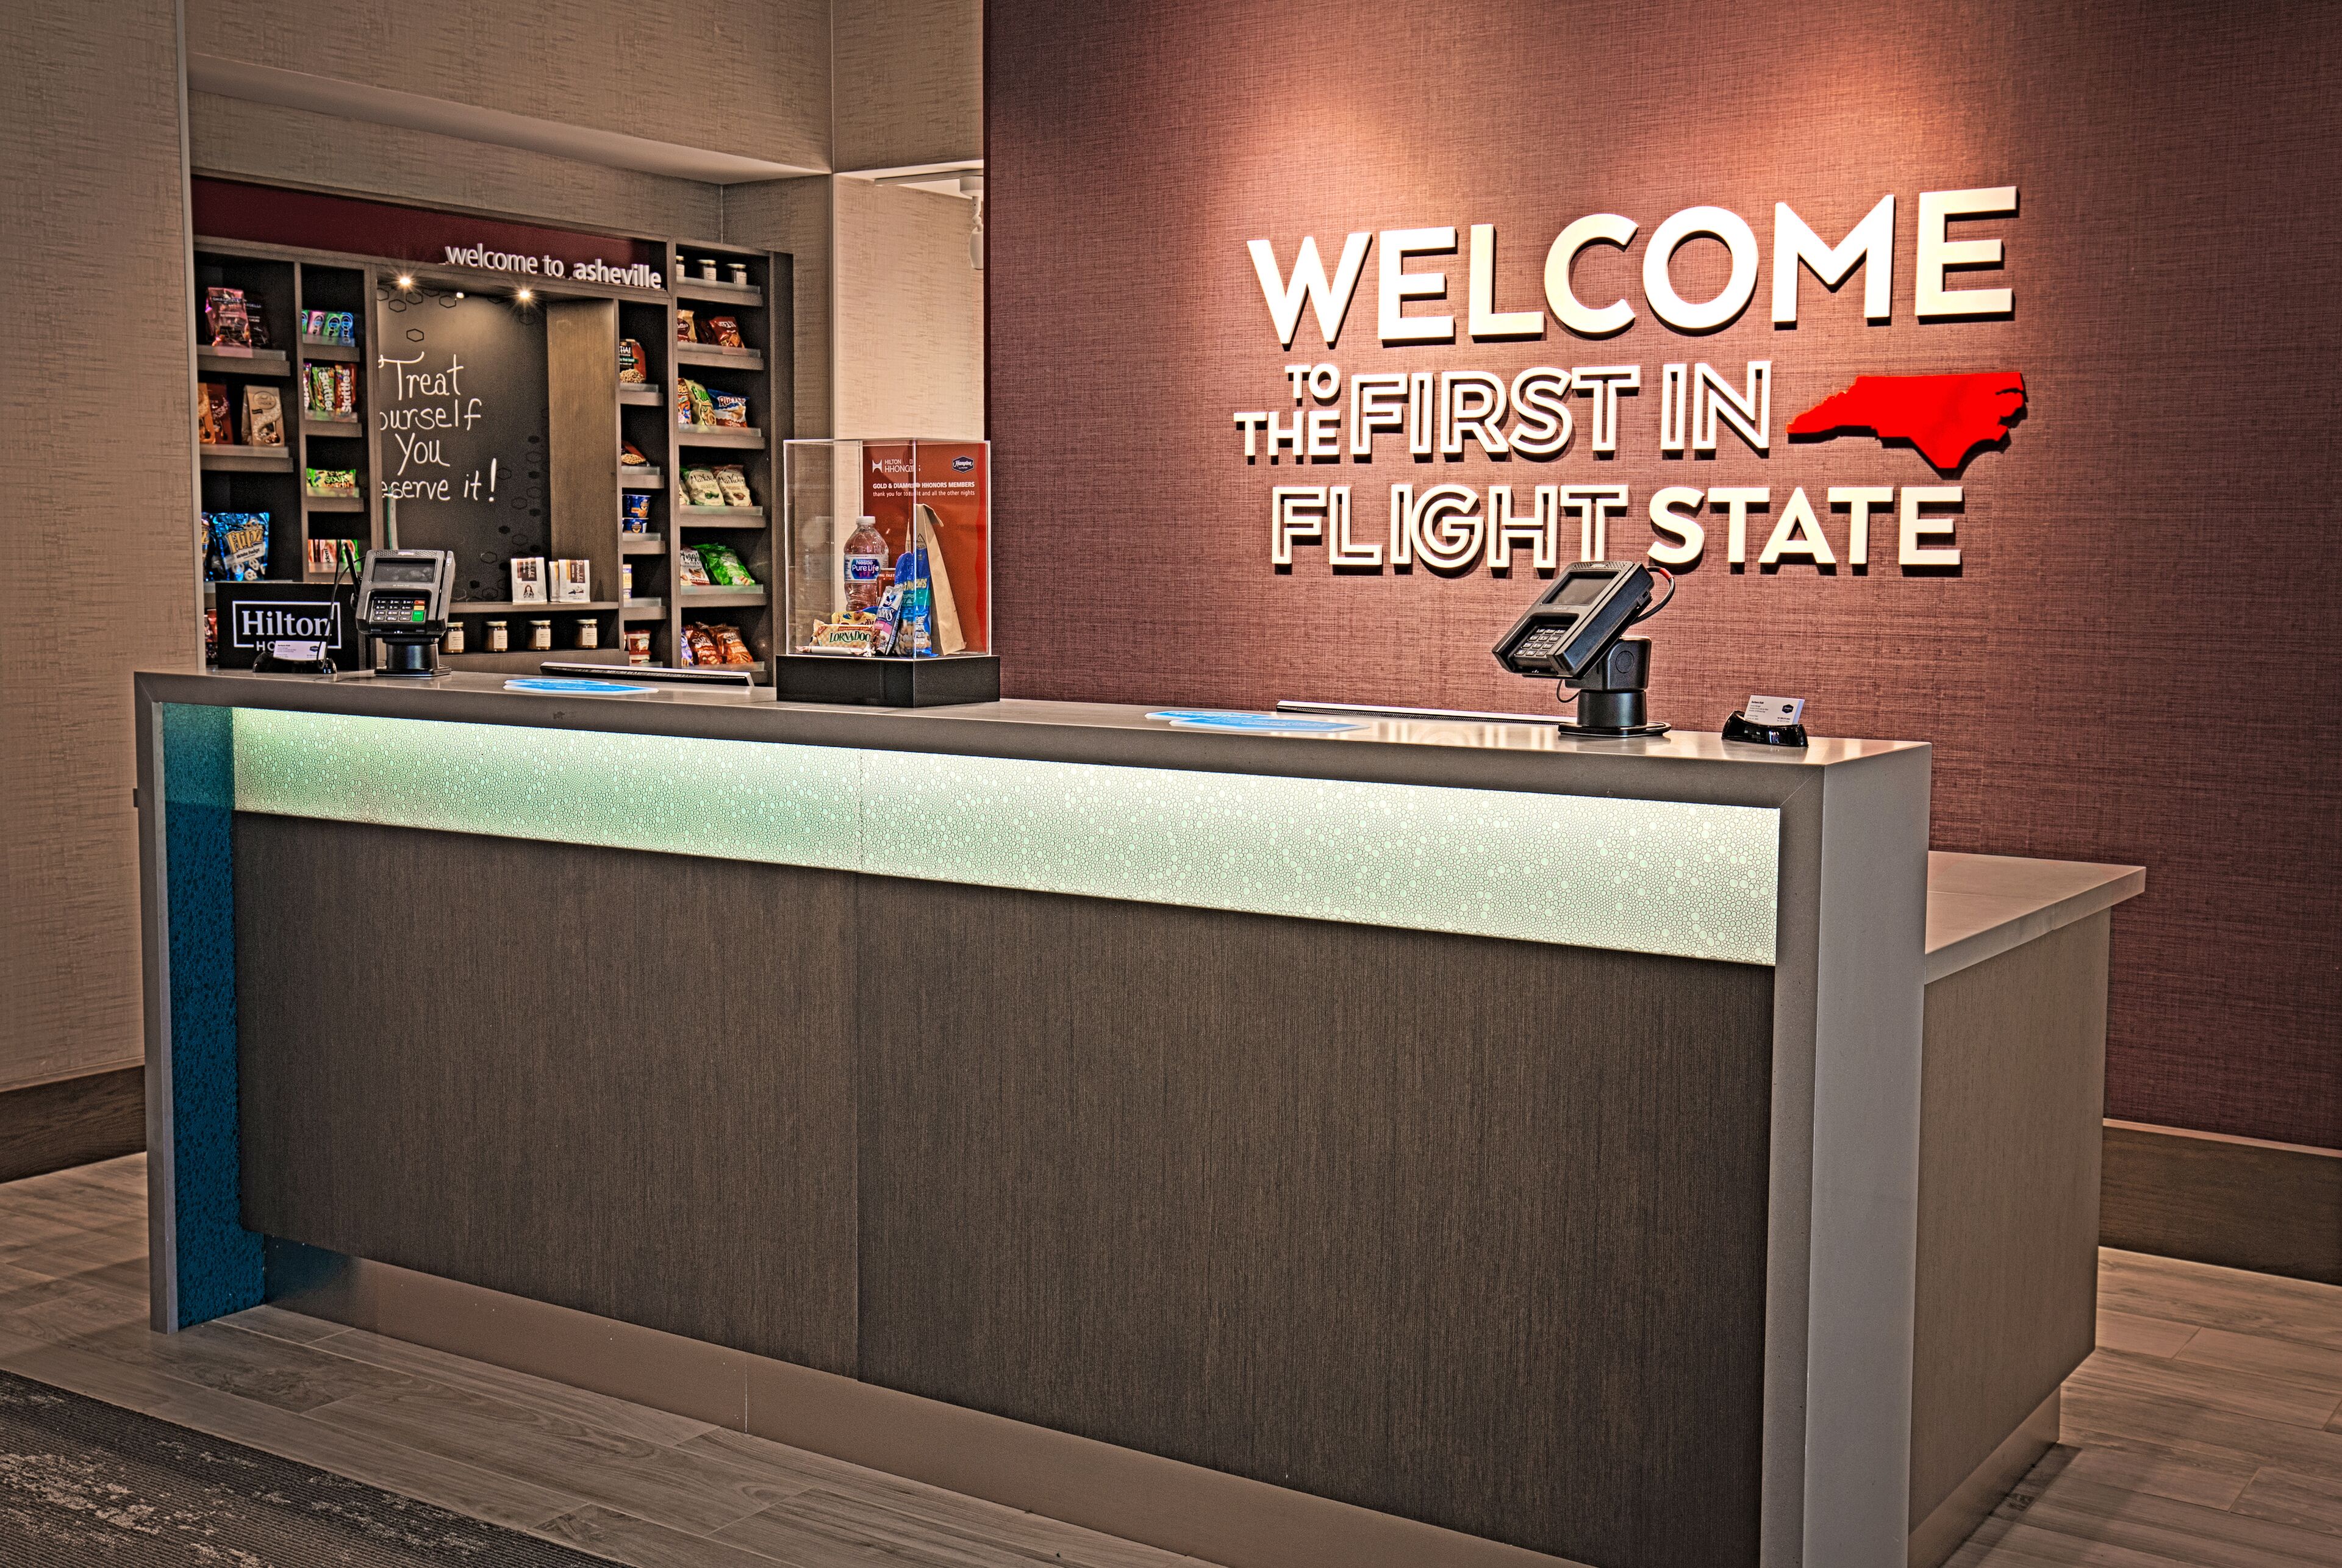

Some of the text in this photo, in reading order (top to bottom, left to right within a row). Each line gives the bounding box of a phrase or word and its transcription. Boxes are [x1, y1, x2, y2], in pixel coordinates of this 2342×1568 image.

[445, 243, 662, 289] welcome to asheville
[1247, 186, 2017, 345] WELCOME
[341, 368, 353, 413] Skittles
[378, 351, 464, 401] Treat
[1285, 363, 1340, 399] TO
[379, 398, 482, 431] ourself
[1234, 361, 1772, 456] THE FIRST IN
[325, 475, 348, 484] SOUR
[381, 458, 497, 502] eserve it!
[225, 529, 263, 554] Flipz
[1272, 484, 1963, 568] FLIGHT STATE
[868, 564, 879, 574] Life
[242, 610, 332, 637] Hilton
[829, 632, 854, 643] LORNA
